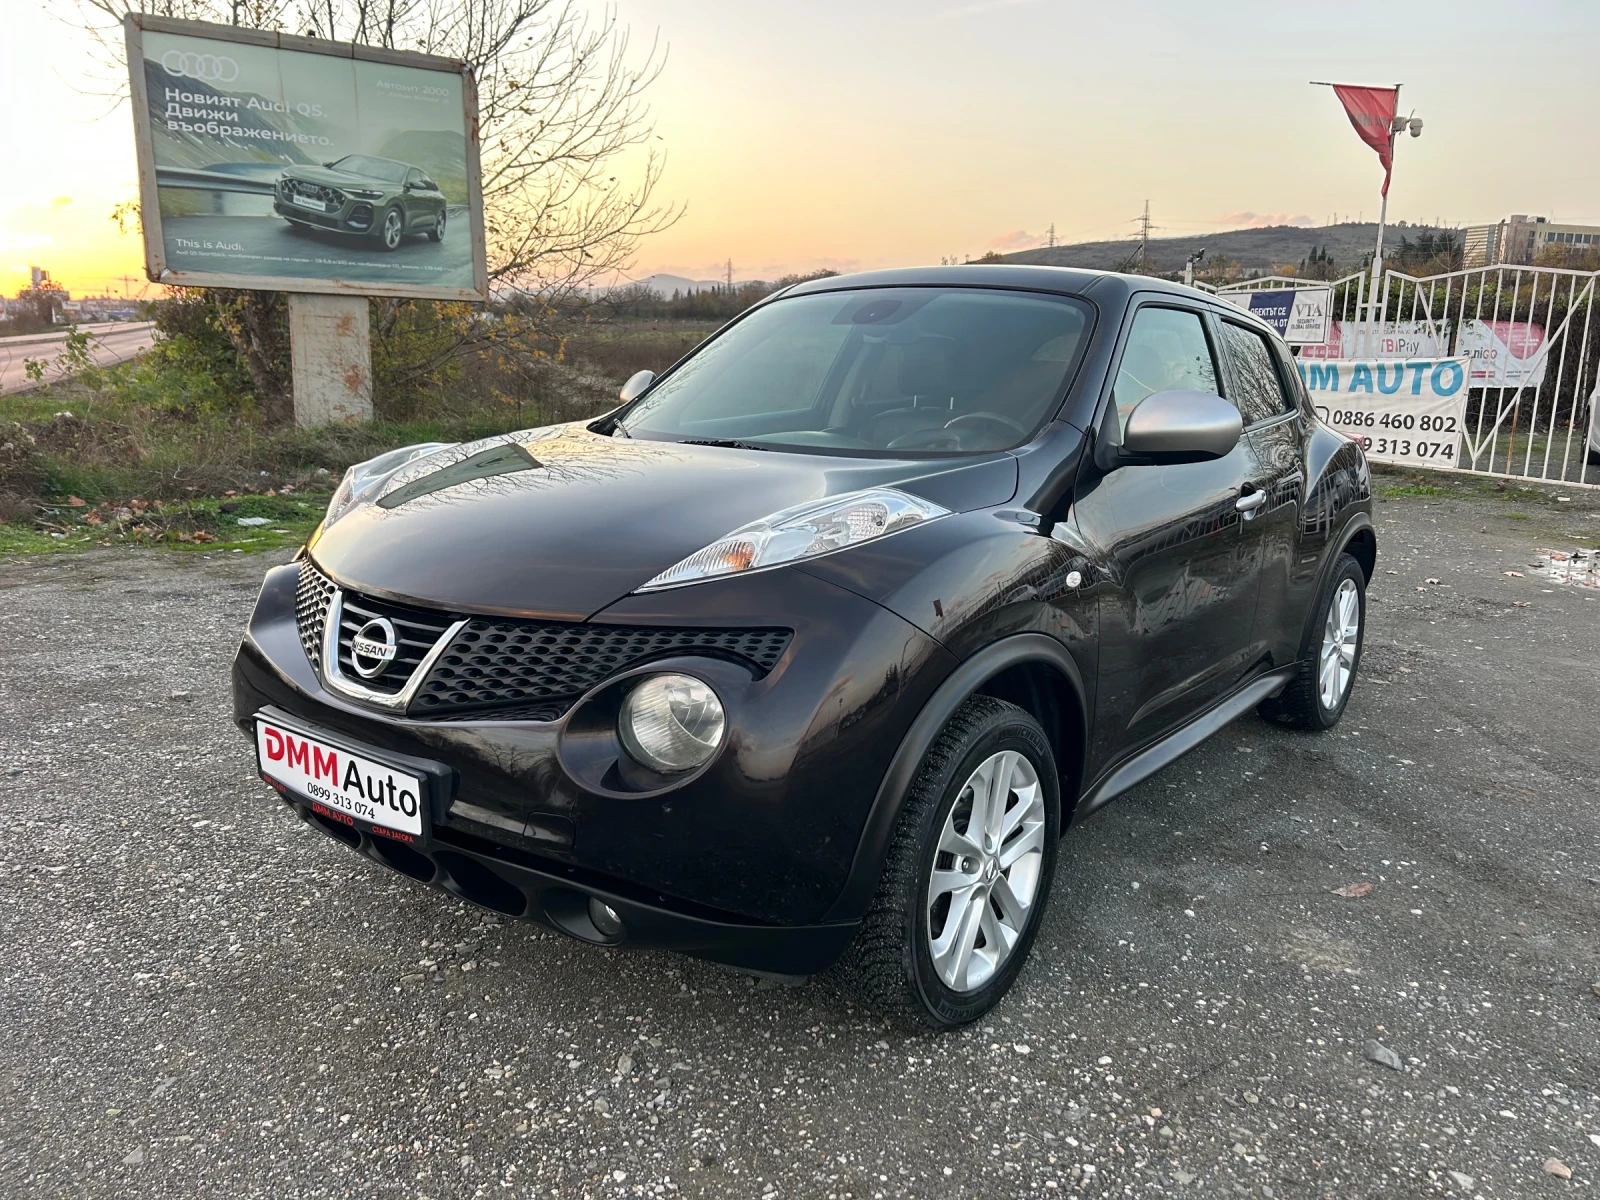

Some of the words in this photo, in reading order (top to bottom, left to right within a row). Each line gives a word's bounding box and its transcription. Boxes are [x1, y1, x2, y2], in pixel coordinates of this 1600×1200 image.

[376, 80, 419, 93] Автохит
[422, 85, 450, 97] 2000
[165, 87, 241, 108] Новият
[246, 96, 291, 113] Audi
[295, 102, 328, 118] Q5.
[165, 102, 239, 122] Движи
[167, 120, 336, 147] въображението.
[175, 238, 200, 249] This
[203, 239, 213, 249] is
[215, 240, 244, 251] Audi.
[1278, 306, 1287, 316] СЕ
[1295, 303, 1323, 317] VTA
[1279, 318, 1288, 328] ОТ
[1348, 360, 1464, 397] AUTO
[1332, 409, 1375, 427] 0886
[1379, 413, 1415, 430] 460
[1420, 415, 1457, 433] 802
[1376, 438, 1411, 456] 313
[1416, 441, 1454, 460] 074
[353, 638, 387, 657] NISSAN
[307, 782, 331, 801] 0899
[332, 792, 352, 811] 313
[354, 801, 376, 820] 074
